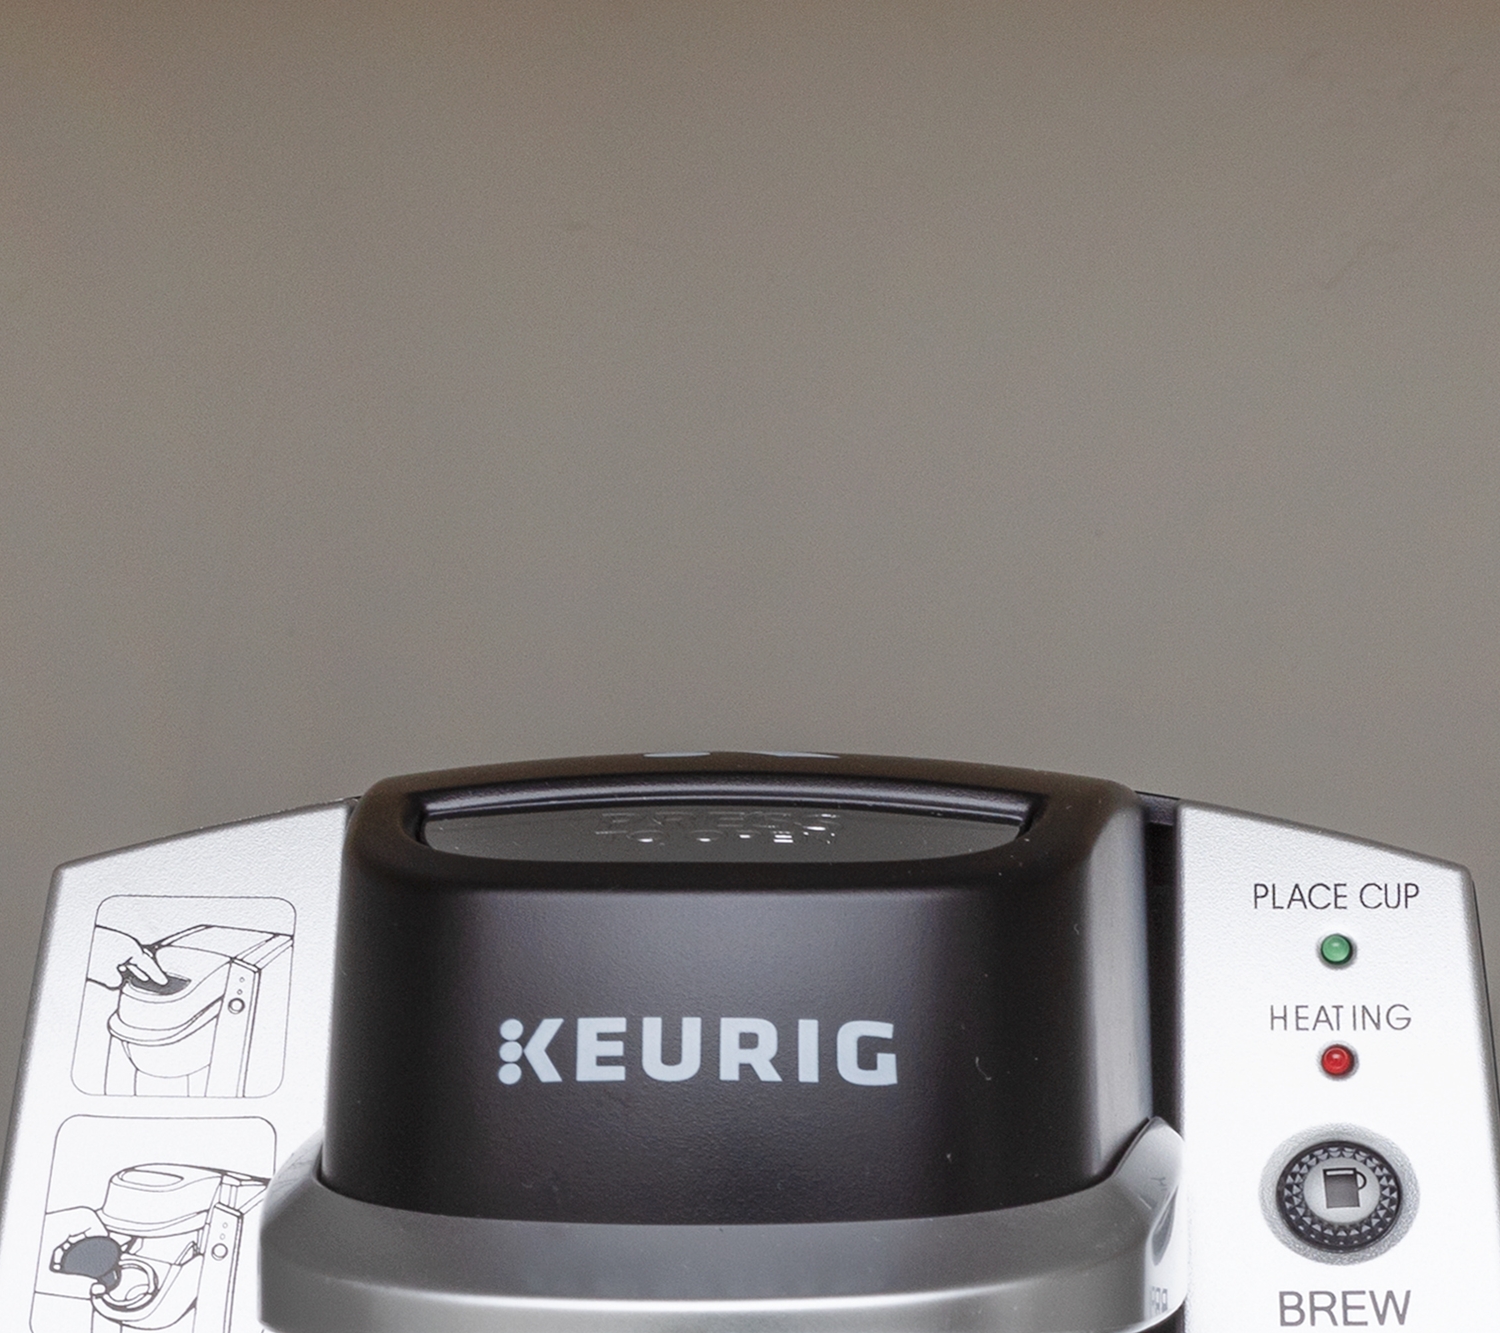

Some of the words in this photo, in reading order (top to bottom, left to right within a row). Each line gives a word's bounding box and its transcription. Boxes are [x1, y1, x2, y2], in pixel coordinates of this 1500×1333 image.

[1253, 883, 1349, 911] PLACE
[1359, 883, 1420, 911] CUP
[1270, 1003, 1413, 1033] HEATING
[499, 1016, 899, 1086] KEURIG
[1278, 1290, 1412, 1328] BREW
